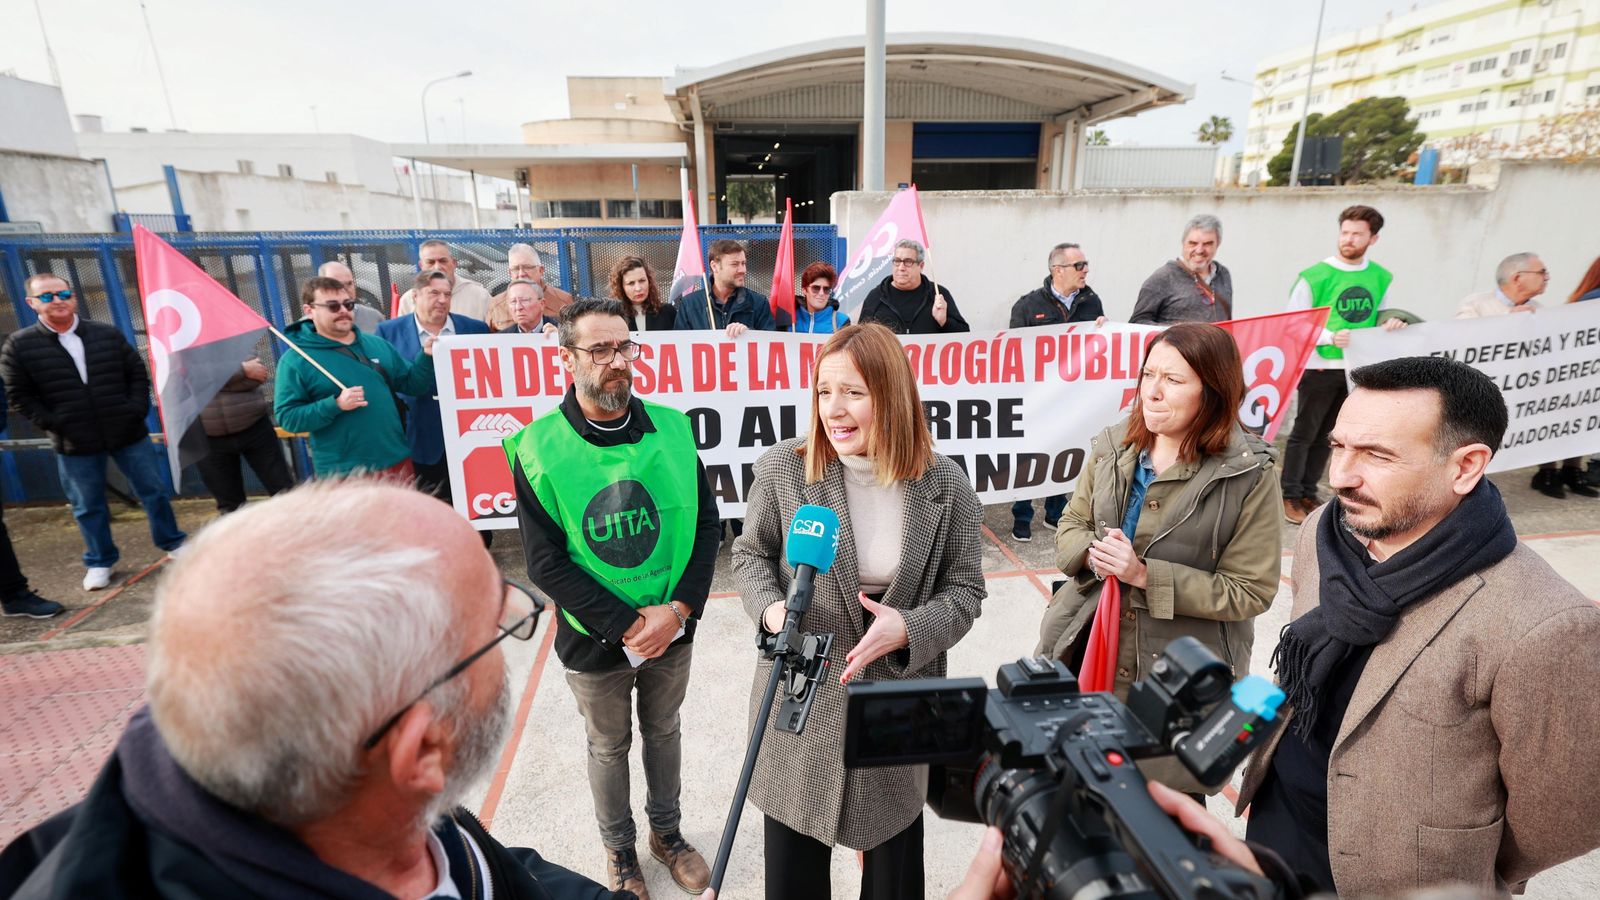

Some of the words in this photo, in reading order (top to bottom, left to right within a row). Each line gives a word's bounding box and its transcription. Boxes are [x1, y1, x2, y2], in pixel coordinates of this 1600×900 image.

[1338, 297, 1372, 312] UITA
[1465, 336, 1552, 364] DEFENSA
[1560, 332, 1570, 351] Y
[1574, 327, 1600, 348] RE
[450, 348, 503, 400] EN
[512, 343, 683, 398] DESA
[691, 343, 738, 393] DE
[748, 342, 791, 391] LA
[799, 331, 1024, 390] MOLOGÍA
[1503, 370, 1541, 391] LOS
[685, 407, 721, 450] O
[920, 398, 1025, 440] RRE
[1586, 414, 1600, 431] D
[587, 506, 656, 542] UITA
